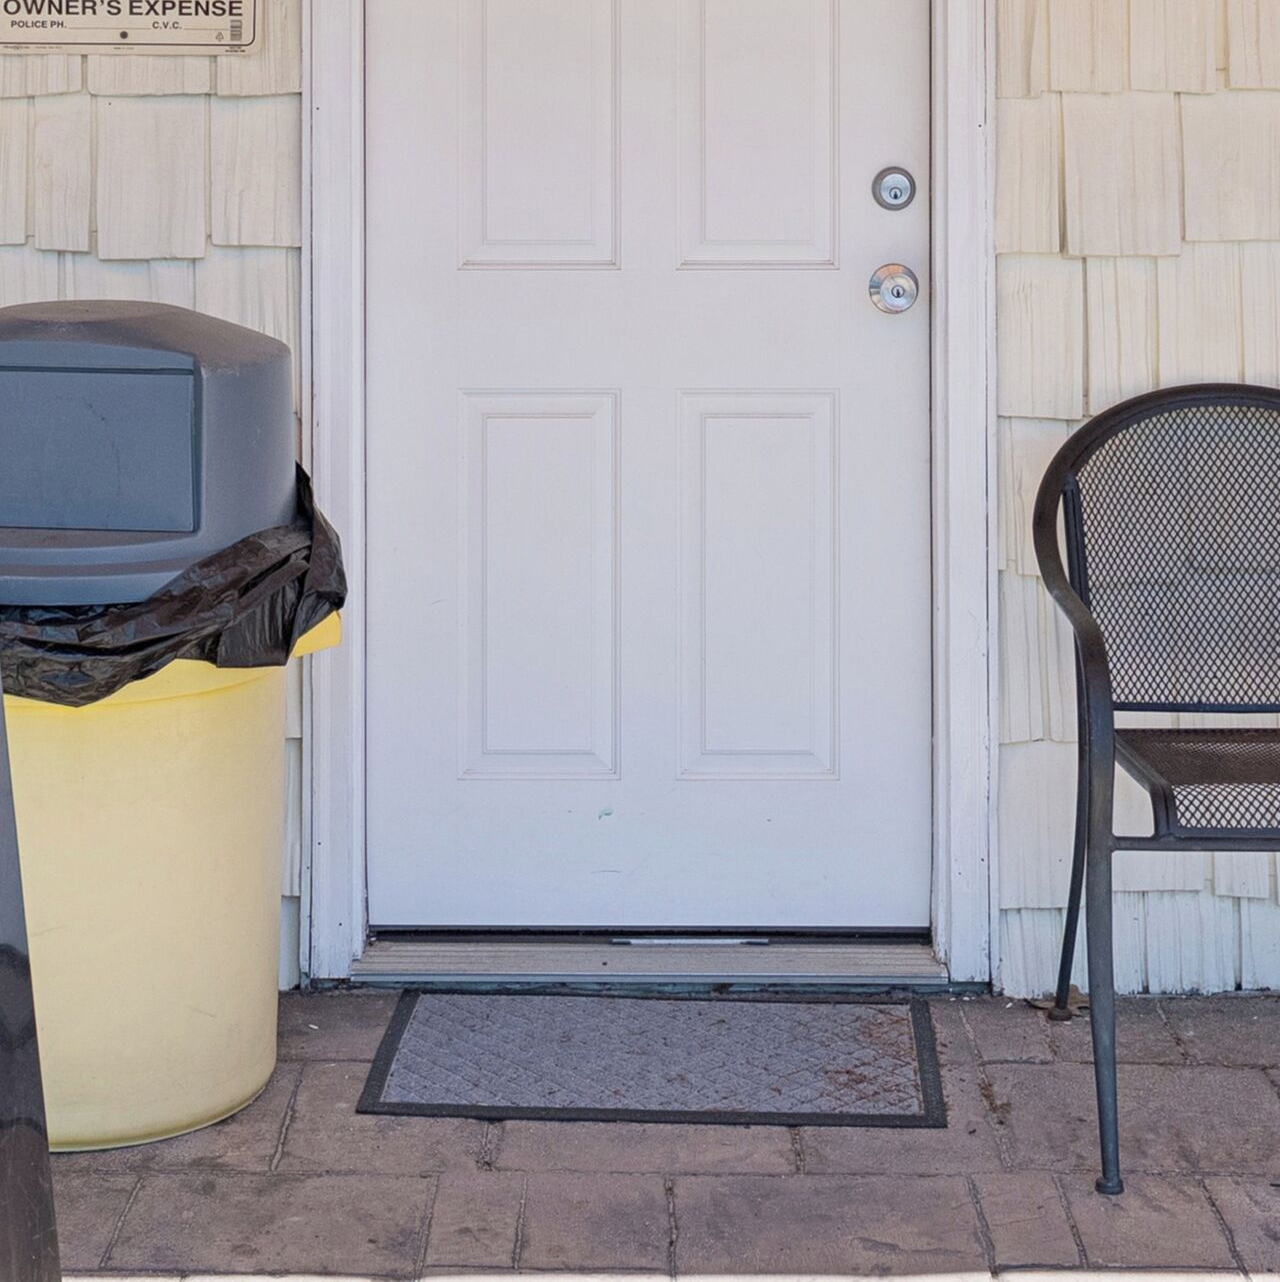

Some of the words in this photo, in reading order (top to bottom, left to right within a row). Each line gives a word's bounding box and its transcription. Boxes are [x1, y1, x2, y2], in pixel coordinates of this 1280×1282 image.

[129, 0, 243, 17] EXPENSE
[10, 20, 47, 29] POLICE
[50, 20, 68, 29] PH.
[152, 21, 182, 30] C.V.C.
